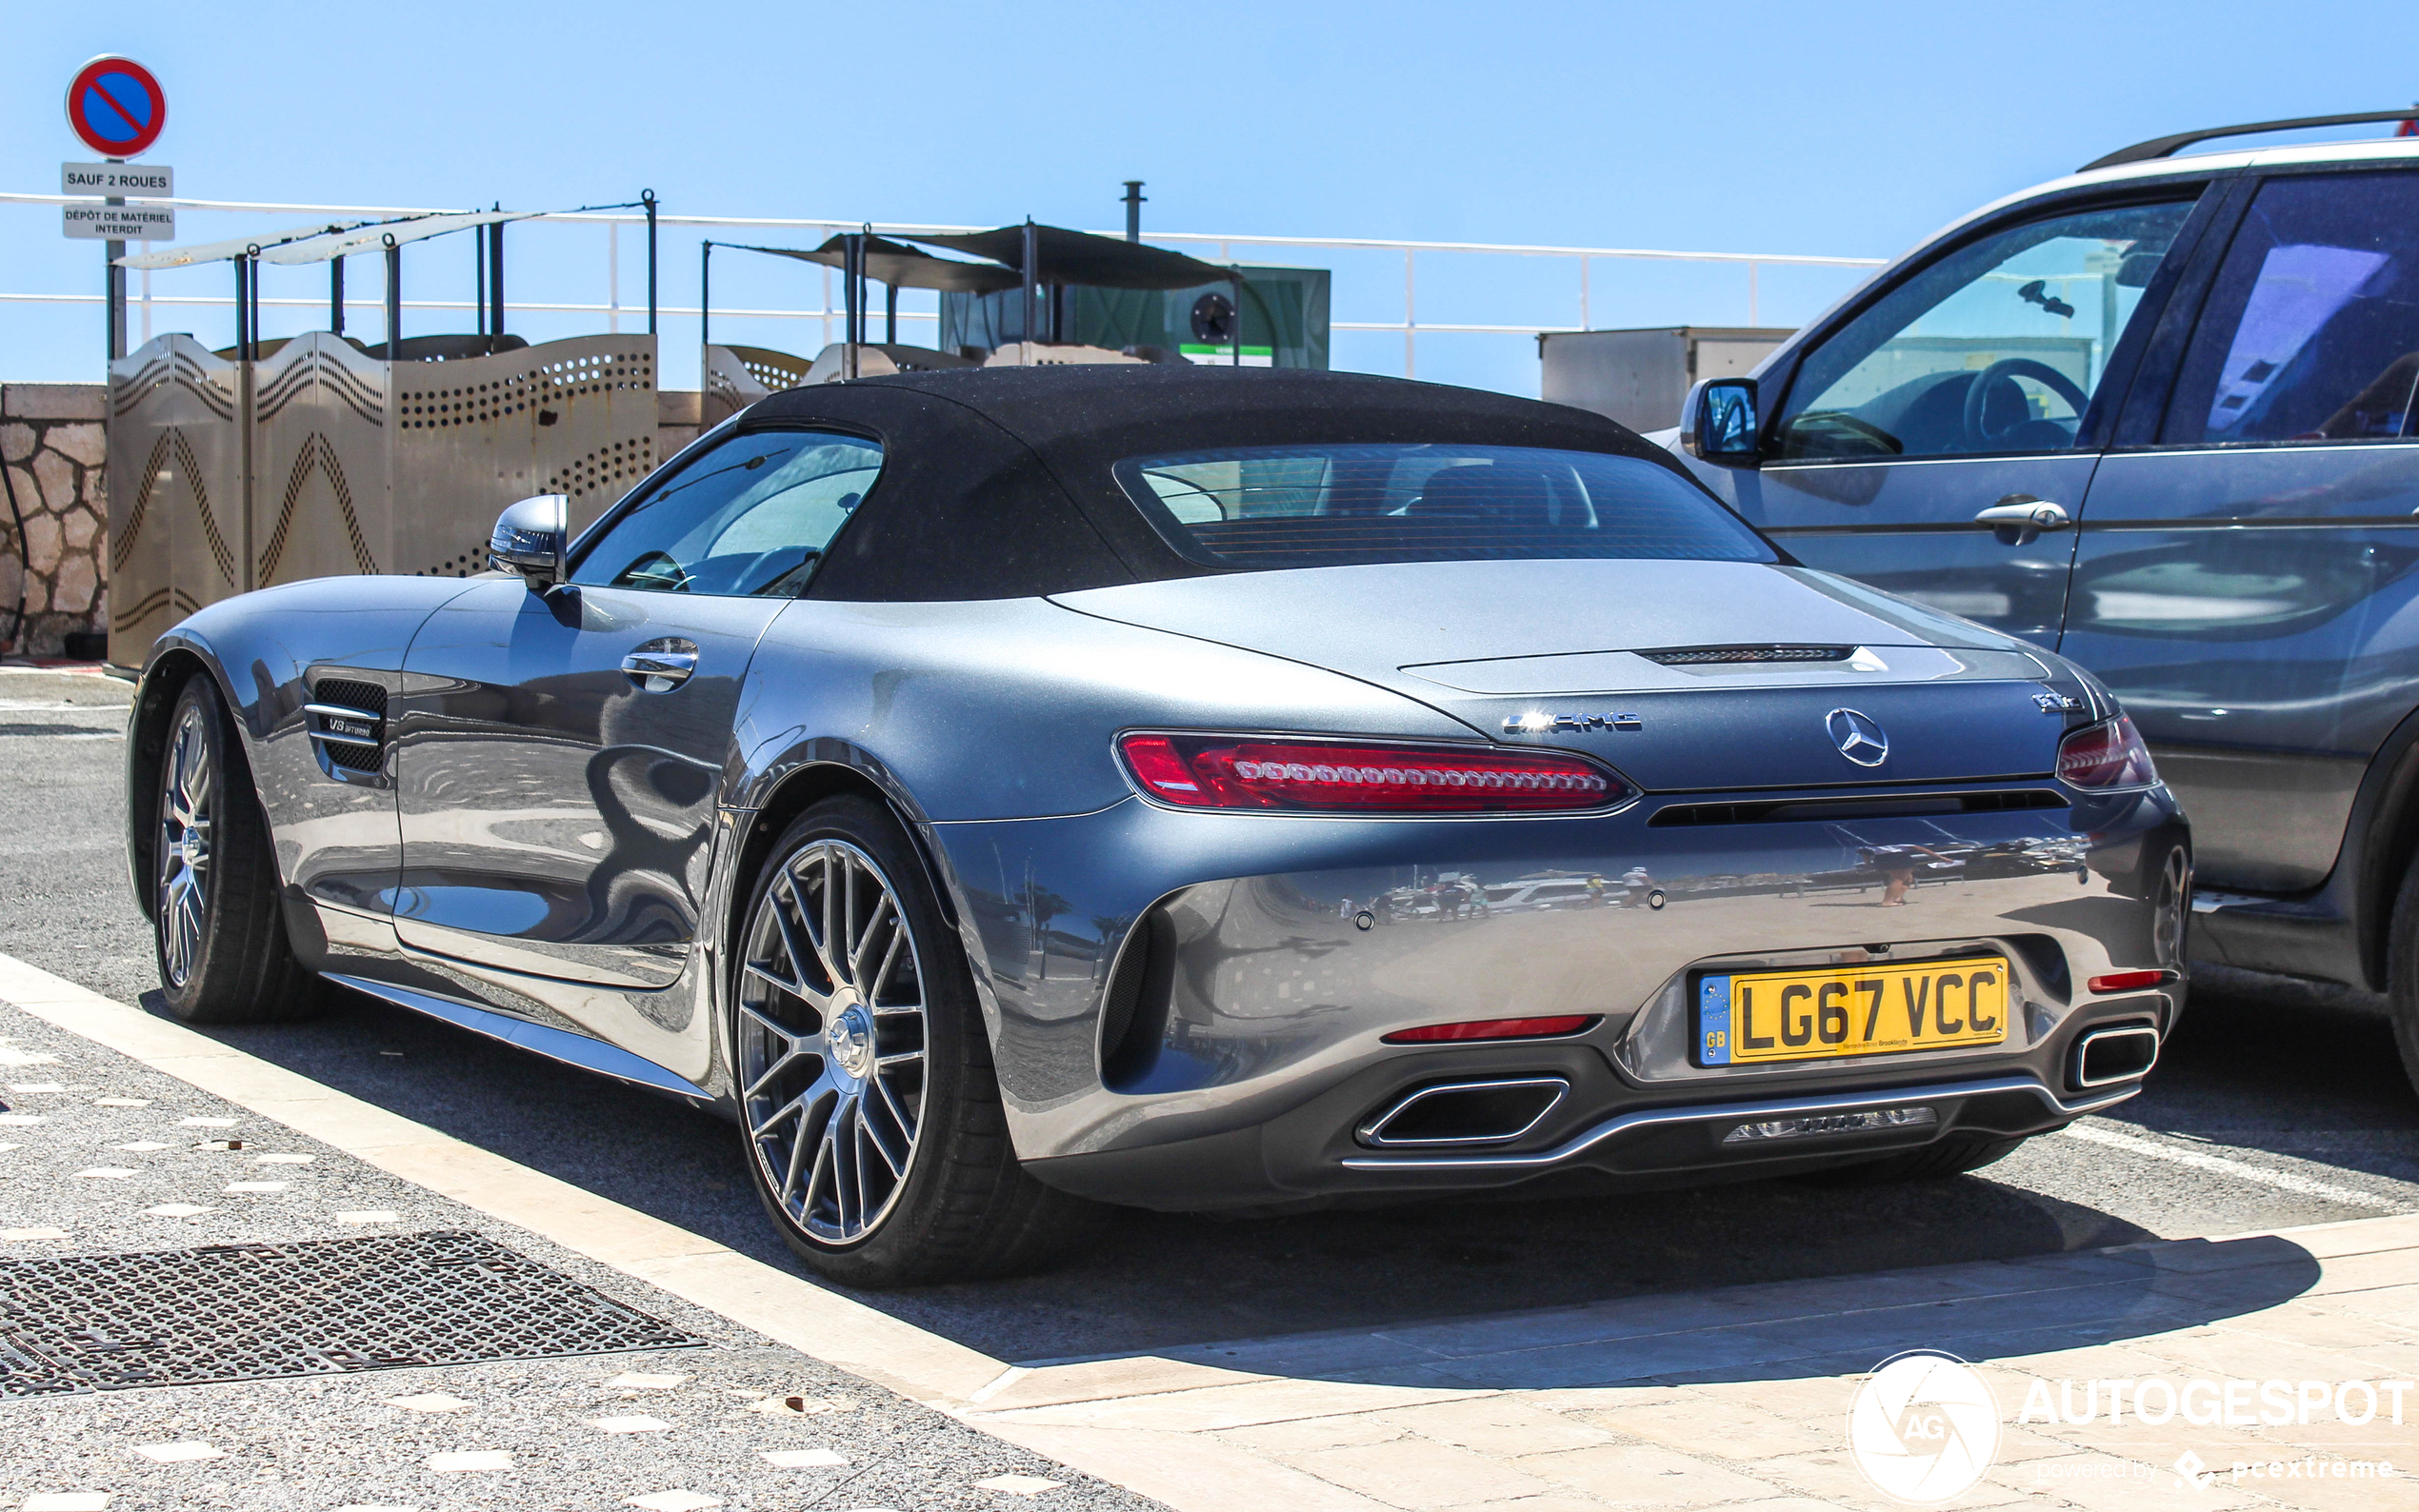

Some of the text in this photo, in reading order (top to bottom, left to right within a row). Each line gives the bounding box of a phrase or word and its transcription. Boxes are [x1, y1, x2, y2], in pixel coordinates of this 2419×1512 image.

[68, 172, 167, 189] SAUF 2 ROUES
[66, 209, 172, 224] DÉPÔT DE MATÉRIEL
[95, 225, 143, 234] INTERDIT
[1549, 711, 1641, 726] AMG
[330, 718, 370, 737] V8 BITURBO
[1742, 971, 1996, 1050] LG67 VCC
[1706, 1030, 1726, 1048] GB
[1878, 1038, 1908, 1046] Brooklands
